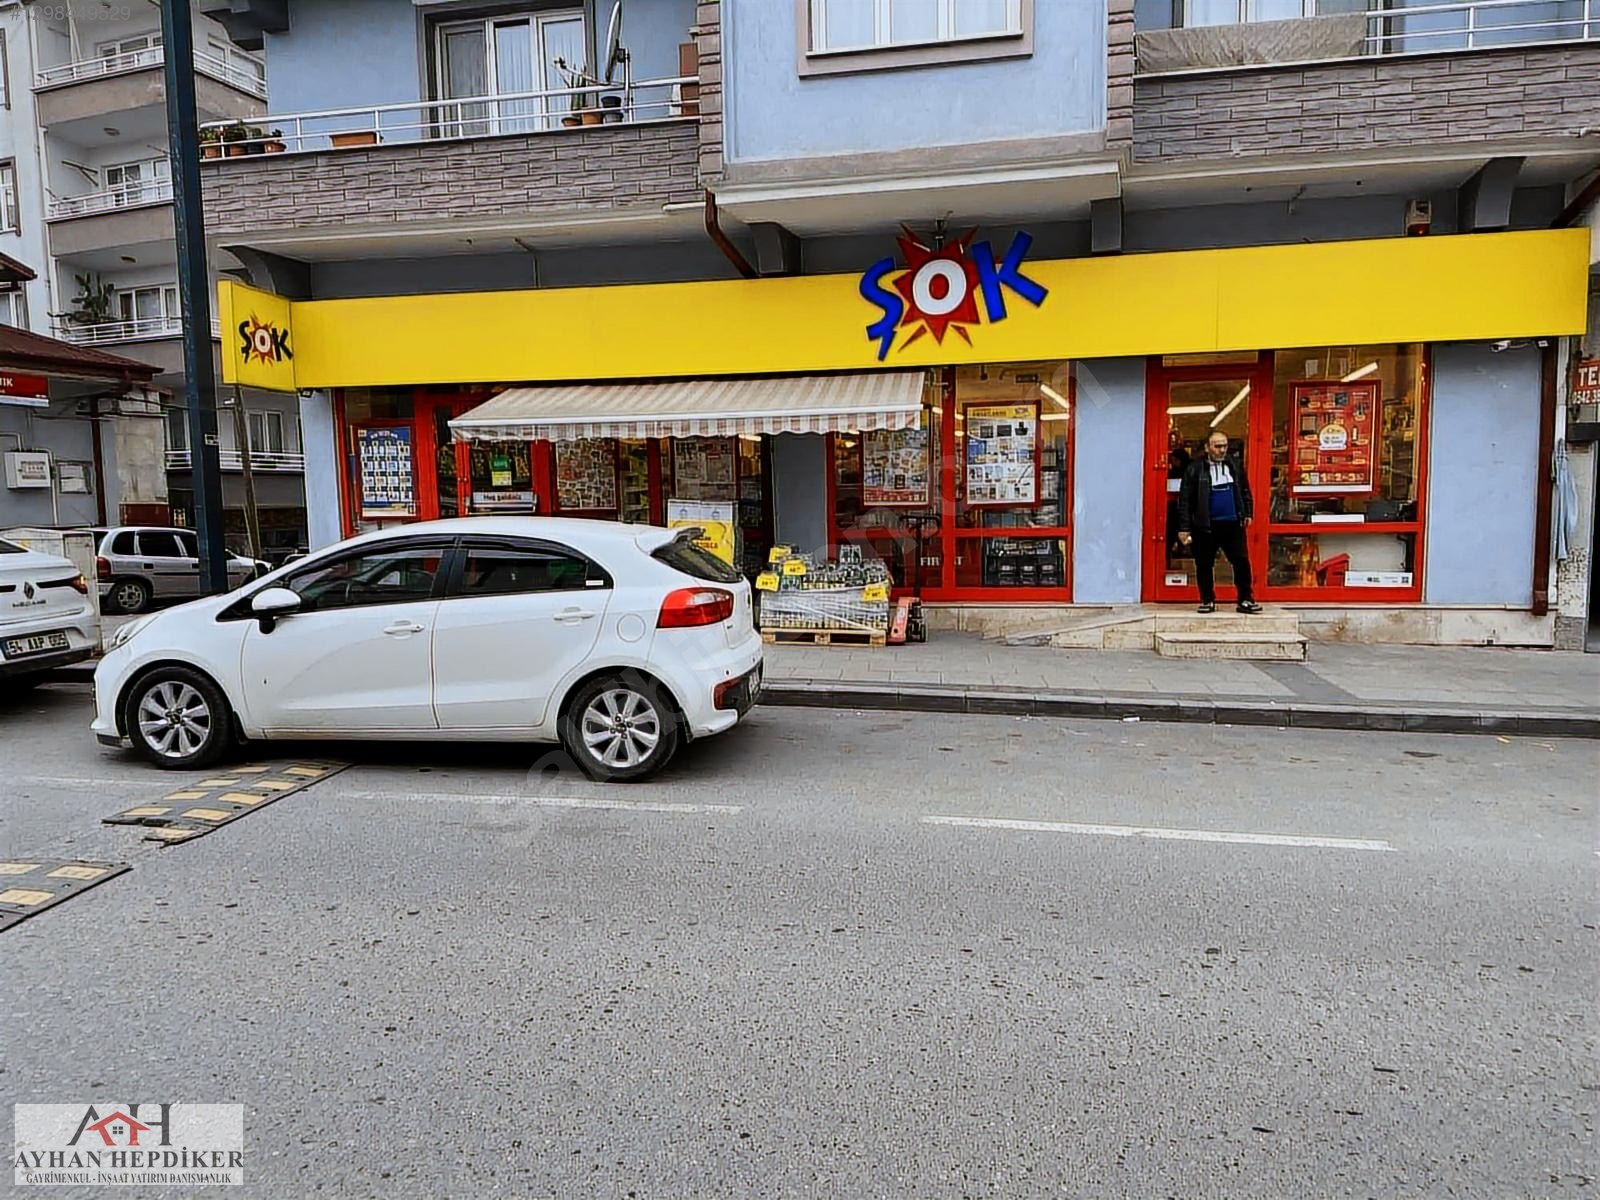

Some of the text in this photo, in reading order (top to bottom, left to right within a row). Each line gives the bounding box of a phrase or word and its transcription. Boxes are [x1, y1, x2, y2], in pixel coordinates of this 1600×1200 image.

[859, 230, 1049, 361] ŞOK
[238, 320, 294, 364] ŞOK
[1578, 366, 1600, 387] TE
